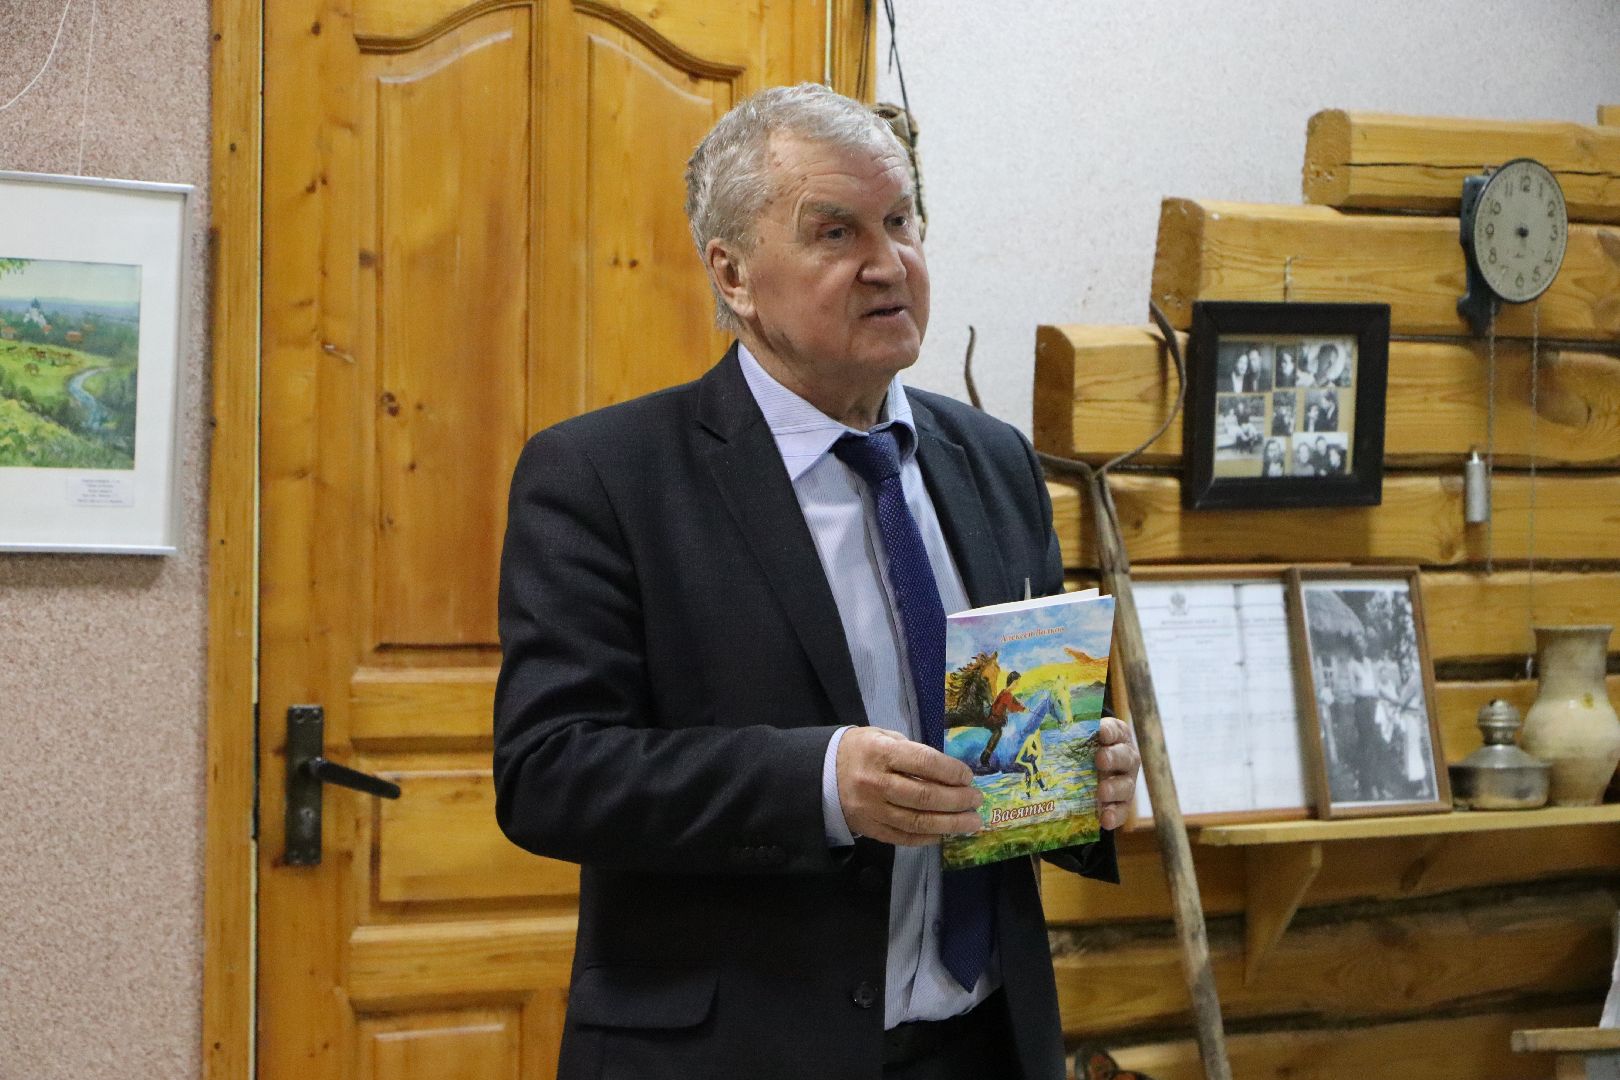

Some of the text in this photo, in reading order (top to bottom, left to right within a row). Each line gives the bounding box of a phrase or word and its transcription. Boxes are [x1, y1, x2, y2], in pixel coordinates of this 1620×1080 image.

[1505, 181, 1514, 198] 11
[1520, 175, 1531, 193] 12
[1490, 201, 1502, 216] 10
[1547, 201, 1556, 218] 2
[1485, 223, 1495, 239] 9
[1549, 224, 1558, 241] 3
[1488, 247, 1497, 265] 8
[1544, 250, 1553, 264] 4
[1515, 272, 1524, 288] 6
[1532, 266, 1541, 282] 5
[991, 800, 1056, 825] Васятка
